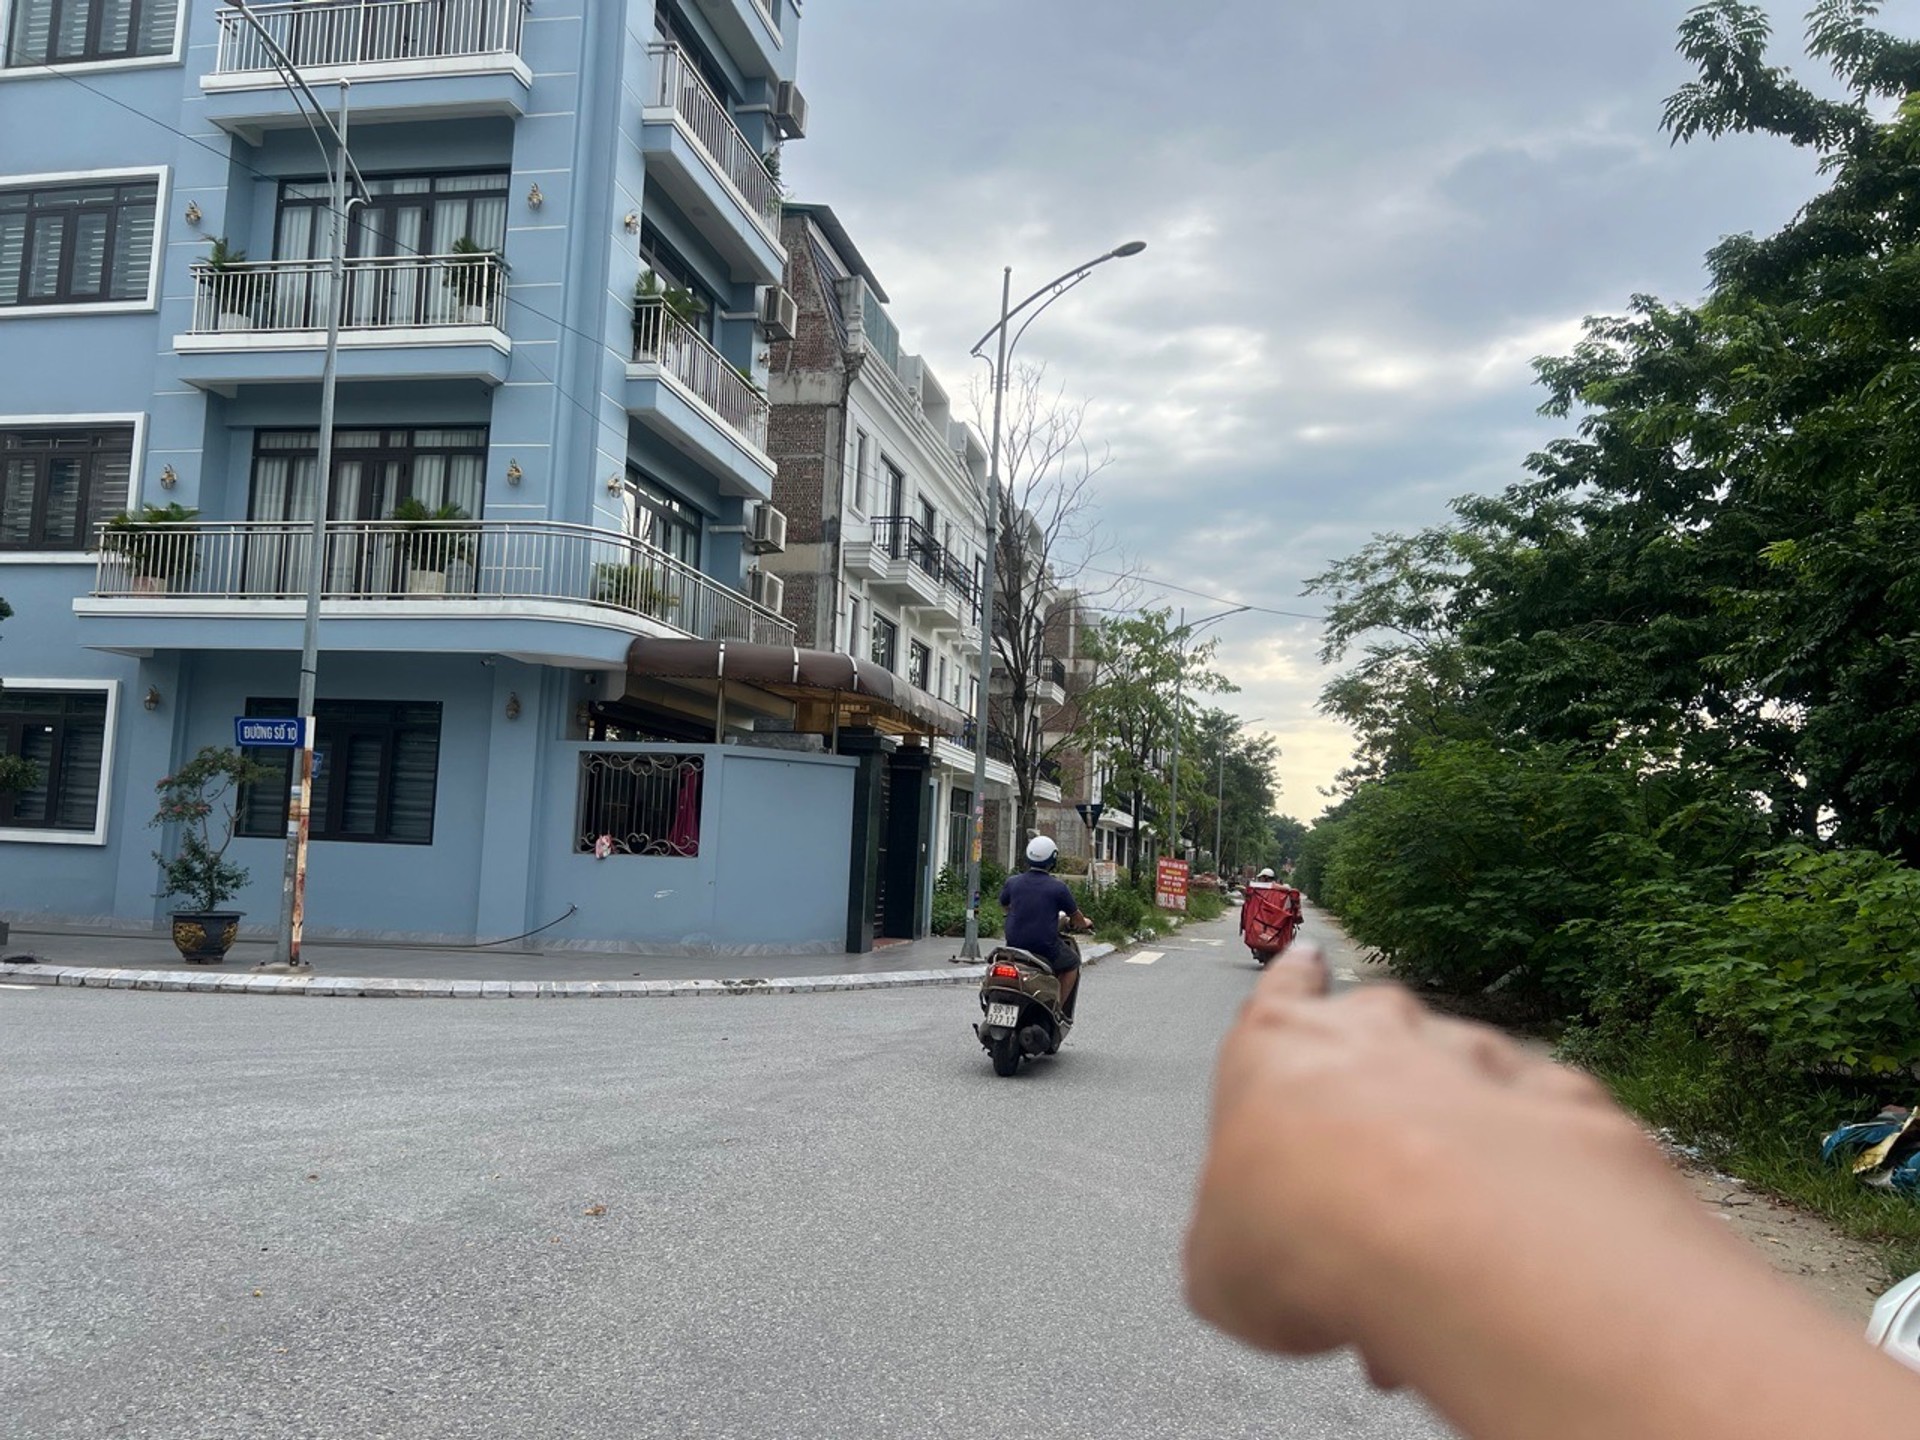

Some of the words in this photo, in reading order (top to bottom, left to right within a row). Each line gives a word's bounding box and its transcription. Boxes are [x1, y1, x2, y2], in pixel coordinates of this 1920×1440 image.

[244, 723, 272, 739] ĐƯỜNG
[274, 723, 286, 740] SỐ
[287, 727, 296, 740] 10
